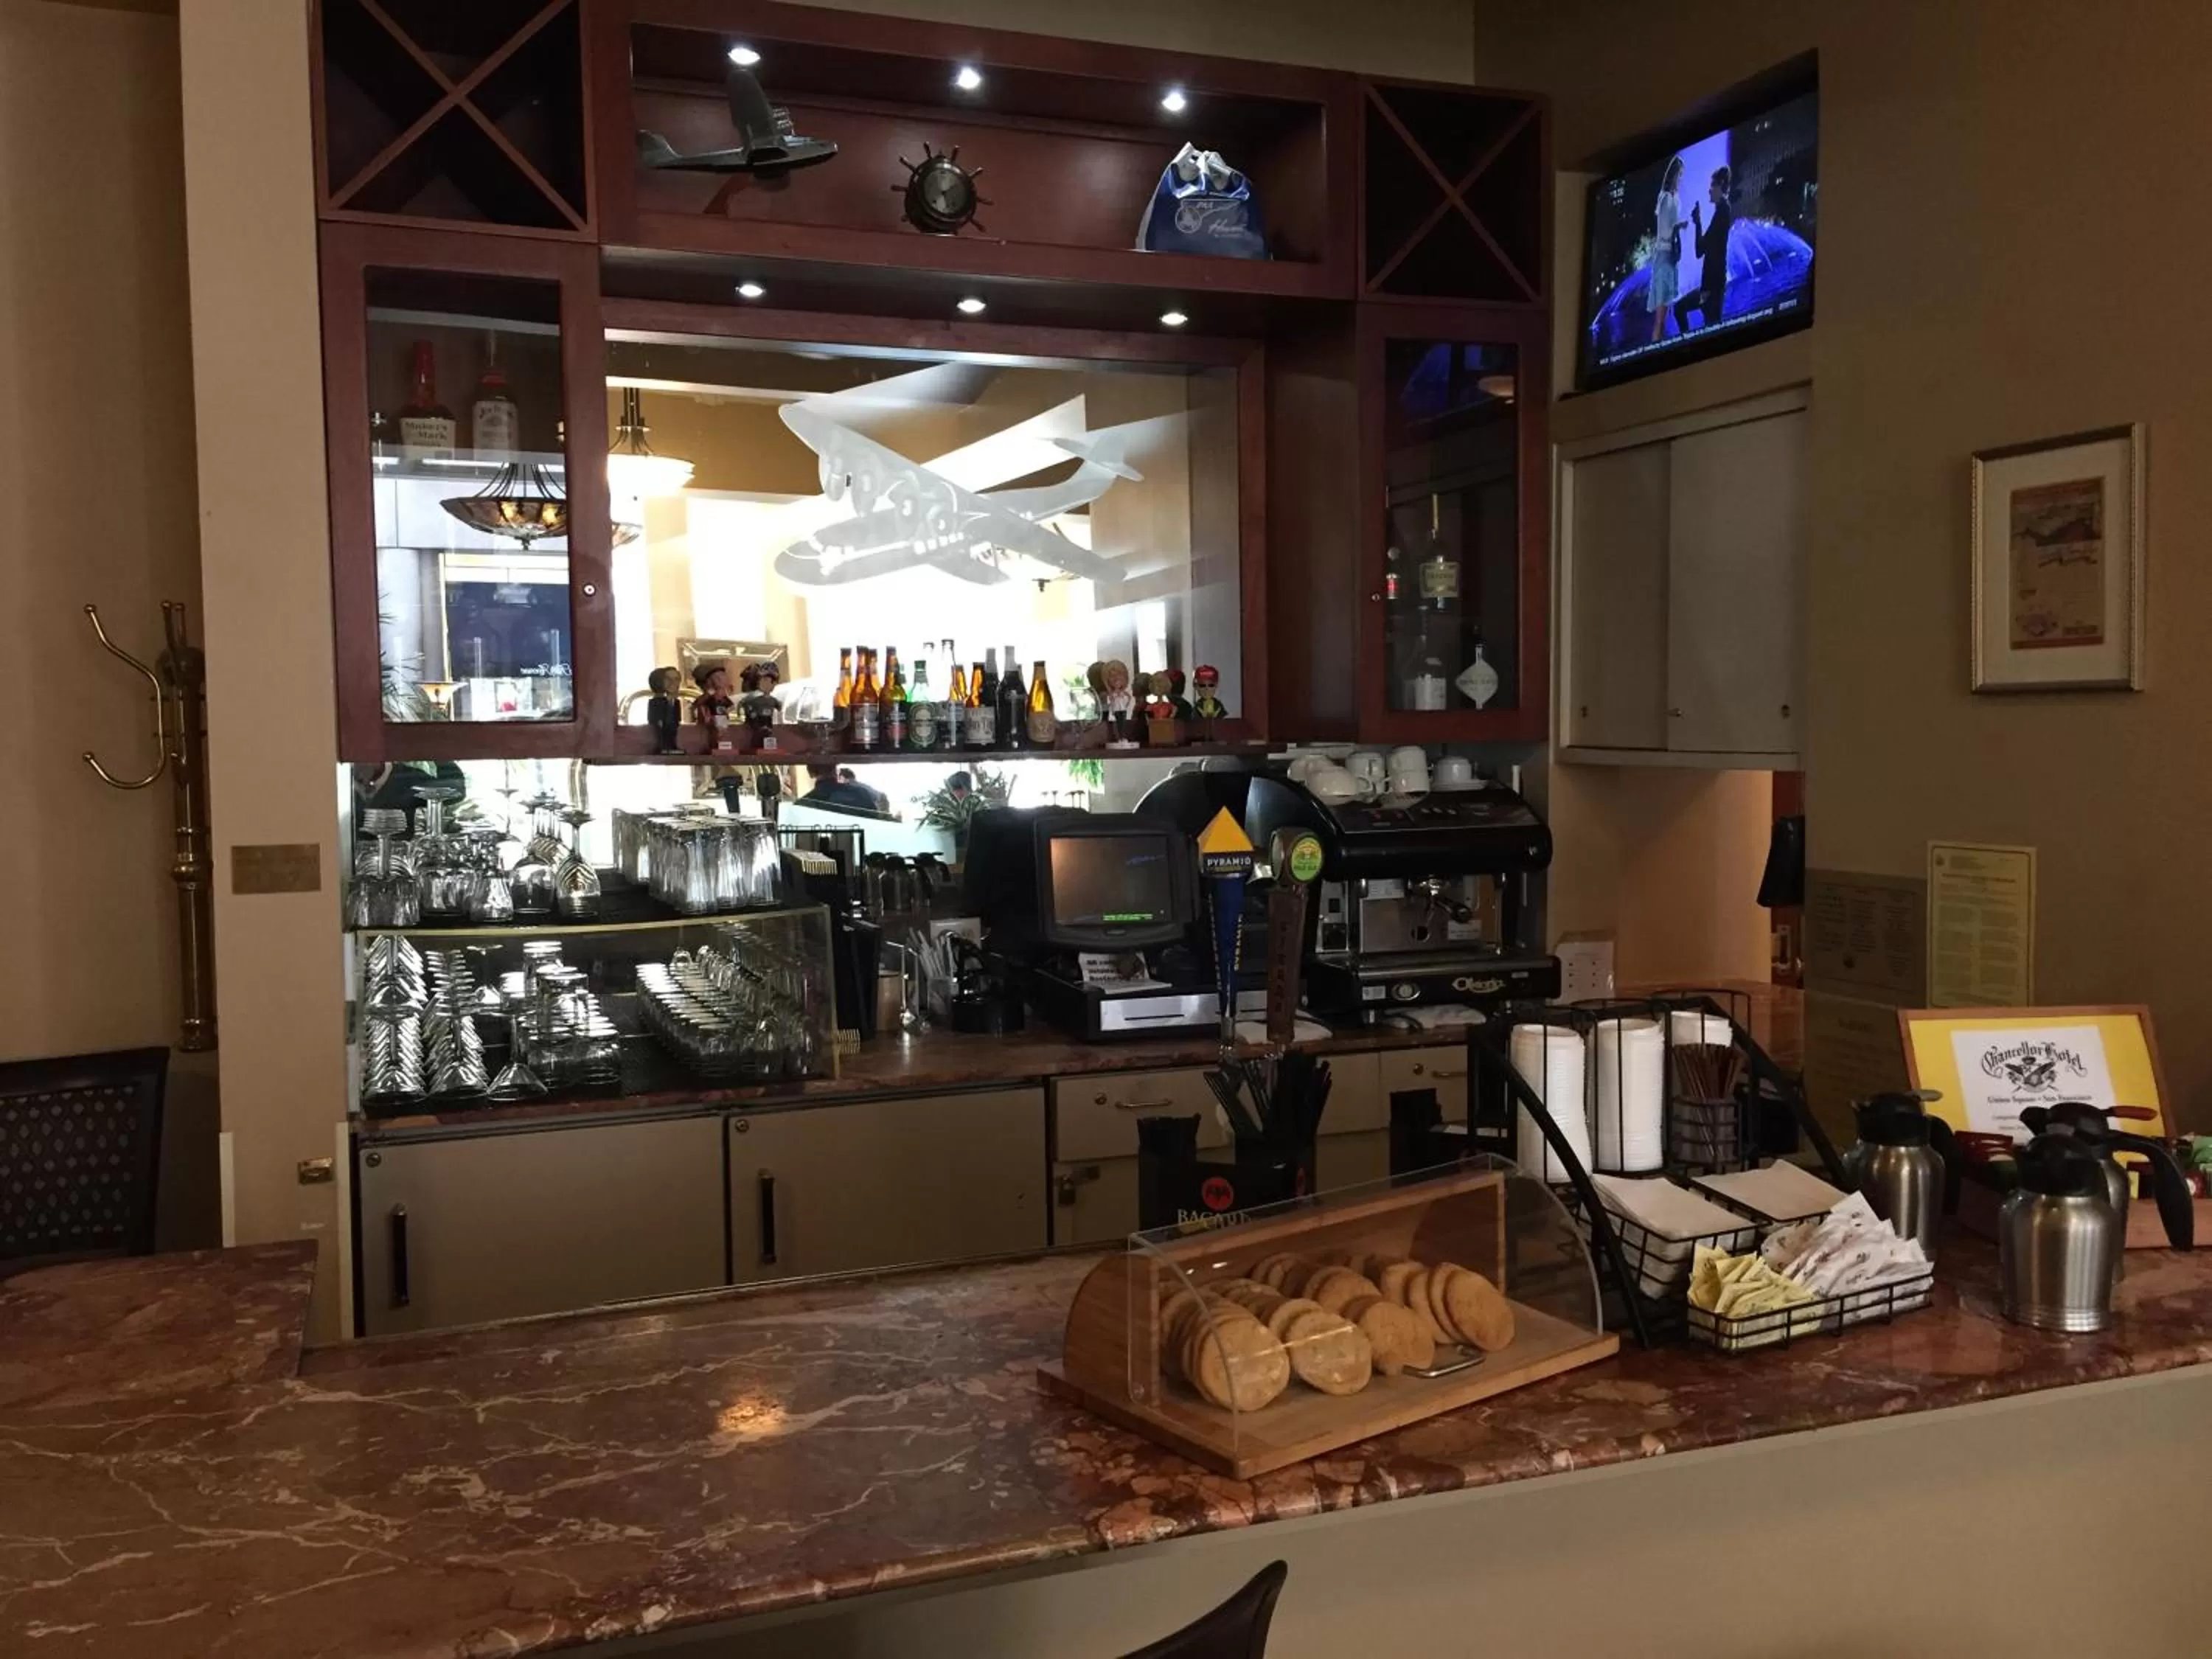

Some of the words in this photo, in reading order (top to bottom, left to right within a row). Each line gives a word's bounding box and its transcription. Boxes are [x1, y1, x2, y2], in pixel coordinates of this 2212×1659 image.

[1207, 855, 1251, 866] PYRAMID
[1981, 1040, 2042, 1079] Chancellor
[2041, 1042, 2088, 1077] Hotel
[1178, 1208, 1252, 1229] BACA
